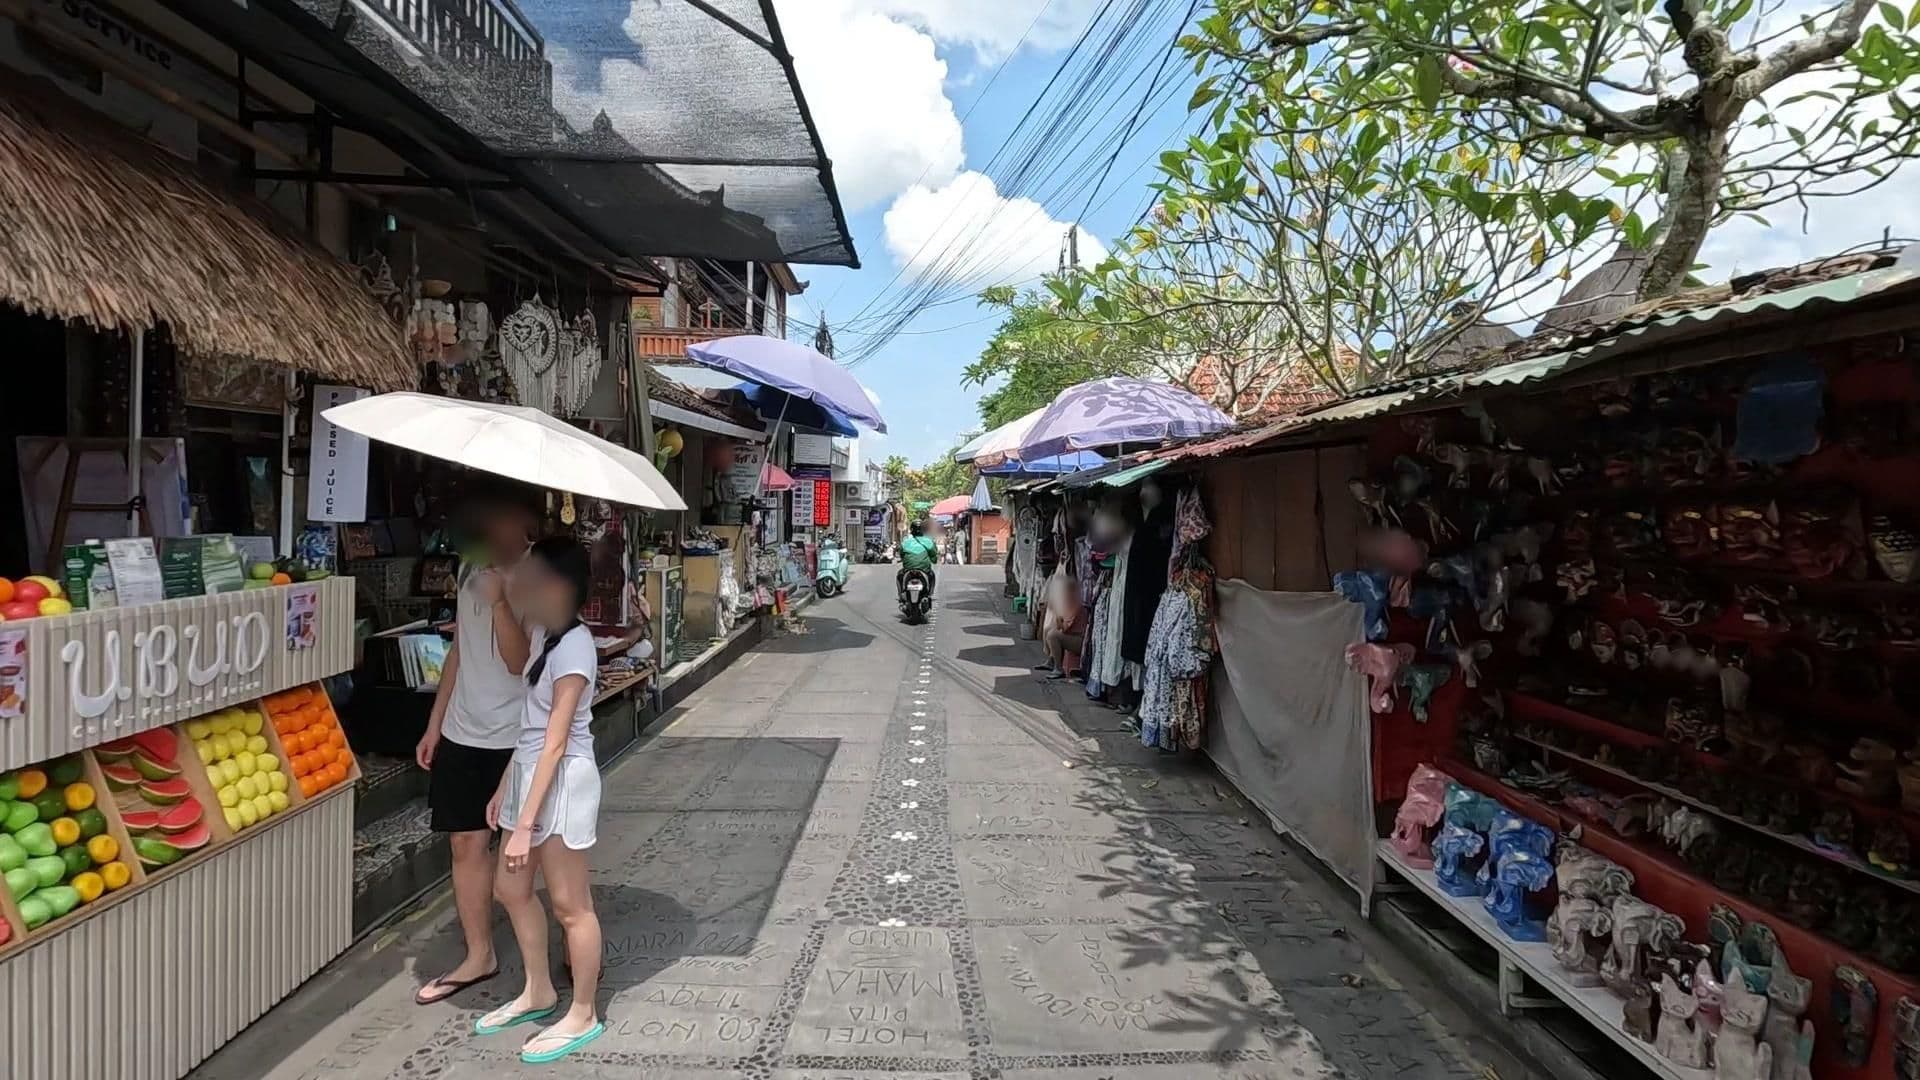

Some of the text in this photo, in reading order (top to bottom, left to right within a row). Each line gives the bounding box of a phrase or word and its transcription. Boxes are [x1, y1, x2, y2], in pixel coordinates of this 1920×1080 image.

[326, 468, 336, 515] JUICE
[61, 610, 271, 719] UBUD
[221, 679, 261, 698] Juice
[848, 929, 933, 947] UBUD
[825, 968, 944, 999] MAHA
[848, 1005, 908, 1023] PITA
[815, 1026, 929, 1046] HOTEL
